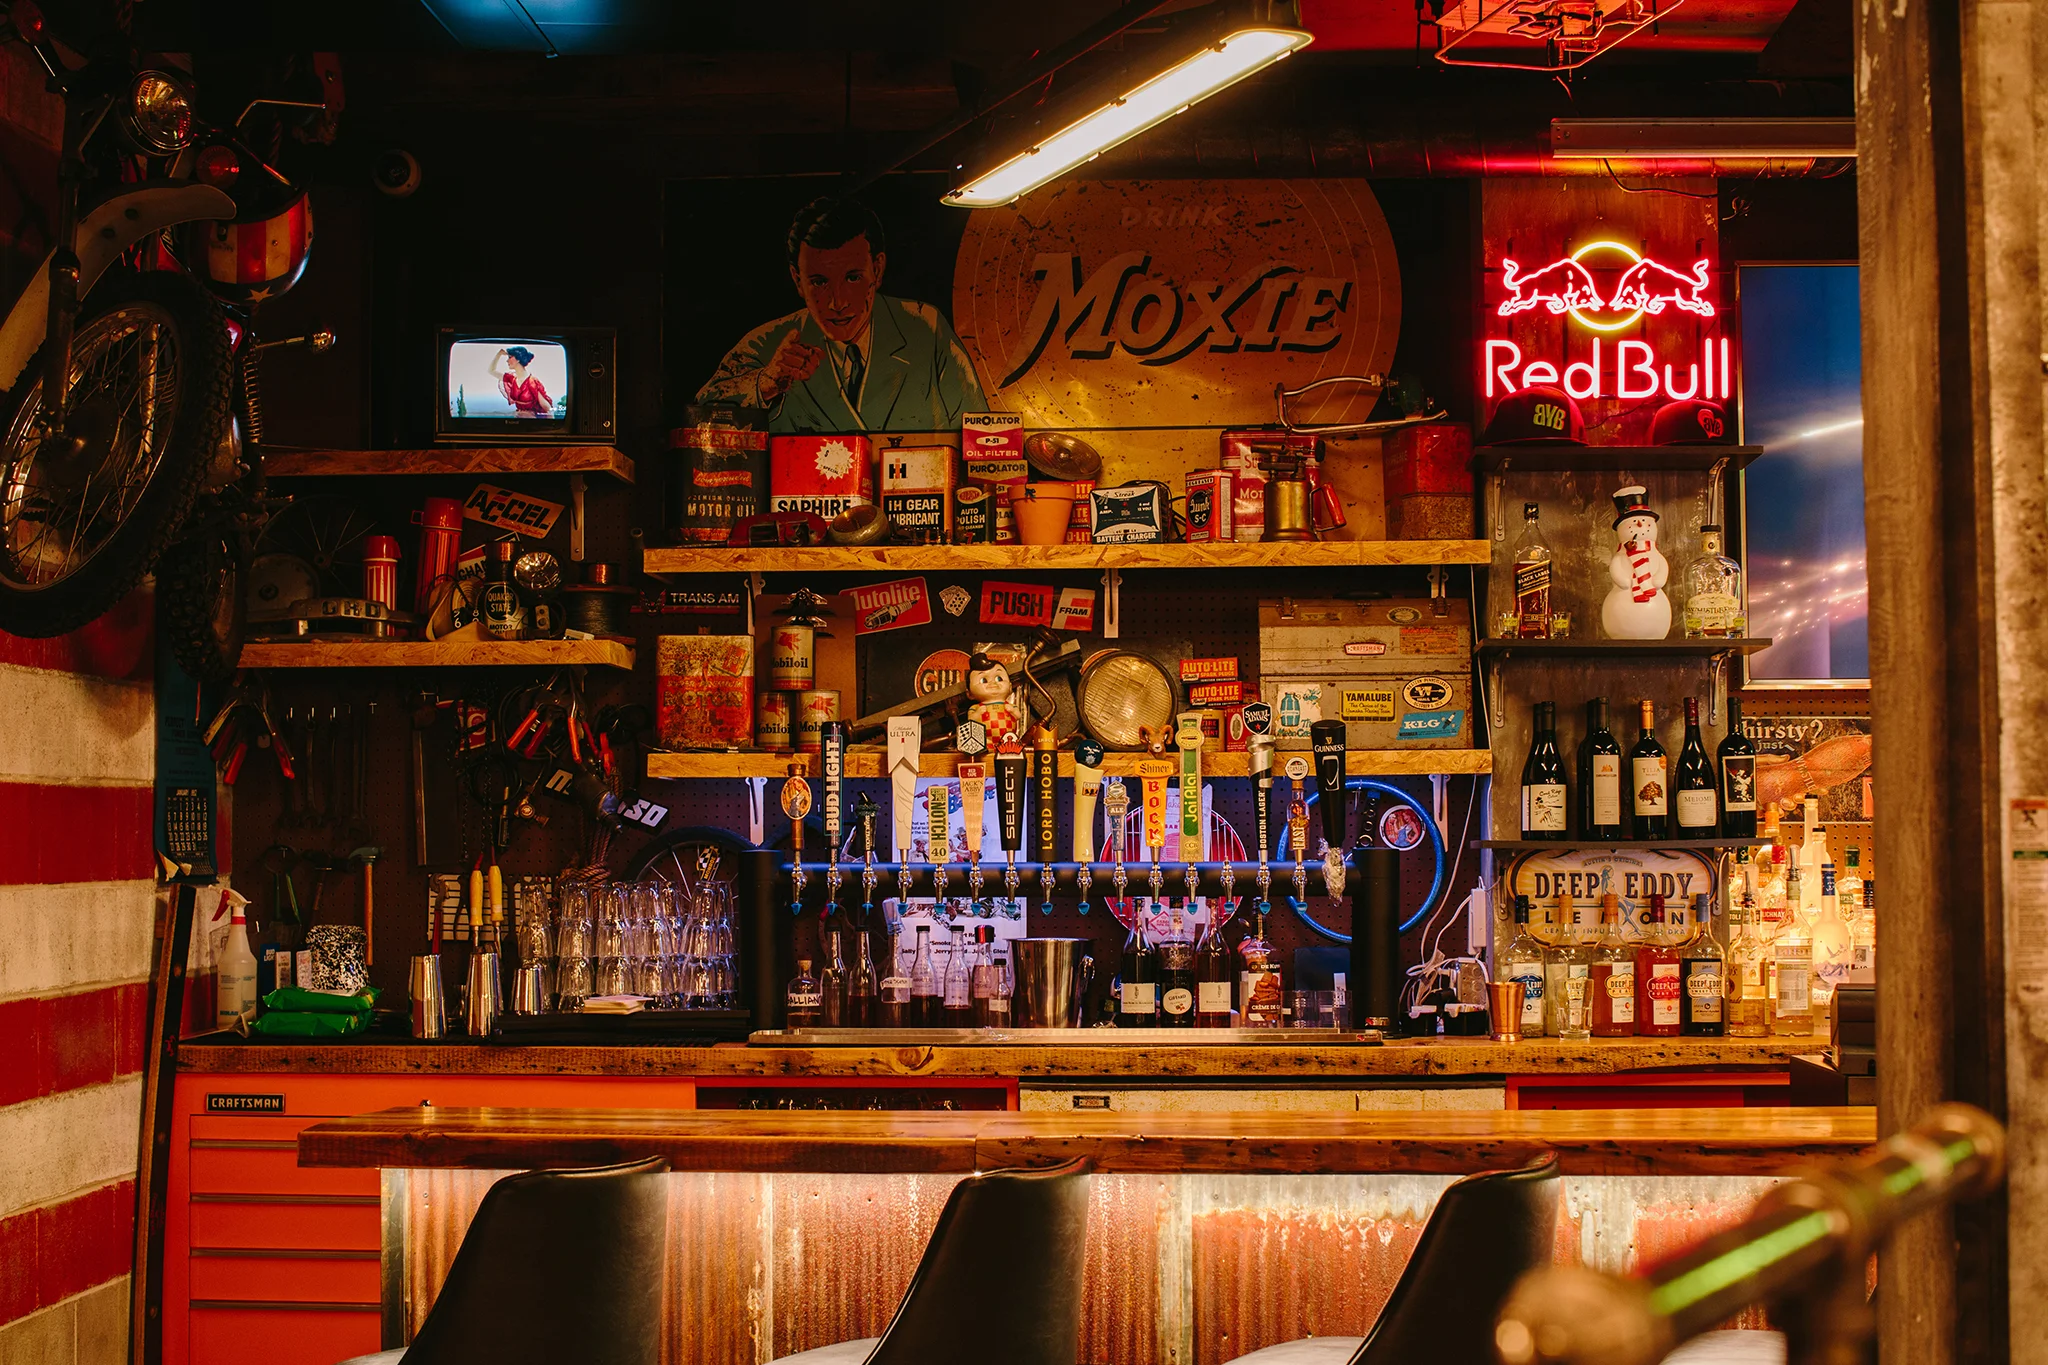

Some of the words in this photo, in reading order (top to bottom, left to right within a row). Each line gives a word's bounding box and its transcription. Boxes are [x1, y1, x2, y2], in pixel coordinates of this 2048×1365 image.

[1486, 337, 1601, 399] Red
[1617, 338, 1729, 400] Bull
[964, 415, 1020, 426] PUROLATOR
[969, 463, 1026, 474] PUROLATOR
[688, 503, 732, 518] MOTOR
[888, 500, 902, 511] IH
[906, 499, 939, 511] GEAR
[1097, 534, 1125, 543] BATTERY
[1127, 532, 1156, 541] CHARGER
[670, 593, 716, 604] TRANS
[718, 594, 740, 604] AM
[490, 603, 512, 613] STATE
[990, 591, 1043, 618] PUSH
[1058, 607, 1088, 617] FRAM
[1345, 693, 1392, 702] YAMALUBE
[1245, 709, 1270, 719] SAMUEL
[1246, 715, 1269, 723] ADAMS
[1741, 719, 1824, 745] hirsty?
[1314, 744, 1345, 753] GUINNESS
[1756, 740, 1784, 753] just
[825, 740, 840, 795] LIGHT
[1139, 763, 1169, 774] Shiner
[1041, 753, 1053, 800] HOBO
[962, 780, 983, 788] JACK'S
[825, 796, 840, 831] BUD
[1148, 781, 1161, 840] BOCK
[931, 801, 946, 841] NOTCH
[1041, 807, 1053, 850] LORD
[931, 848, 947, 857] 40
[1583, 856, 1611, 868] AUSTIN'S
[1613, 856, 1643, 868] ORIGINAL
[1534, 872, 1601, 899] DEEP
[1624, 873, 1694, 900] EDDY
[1610, 980, 1625, 988] DEEP
[1652, 982, 1666, 990] DEEP
[1813, 993, 1830, 1001] GREY
[211, 1095, 281, 1110] CRAFTSMAN
